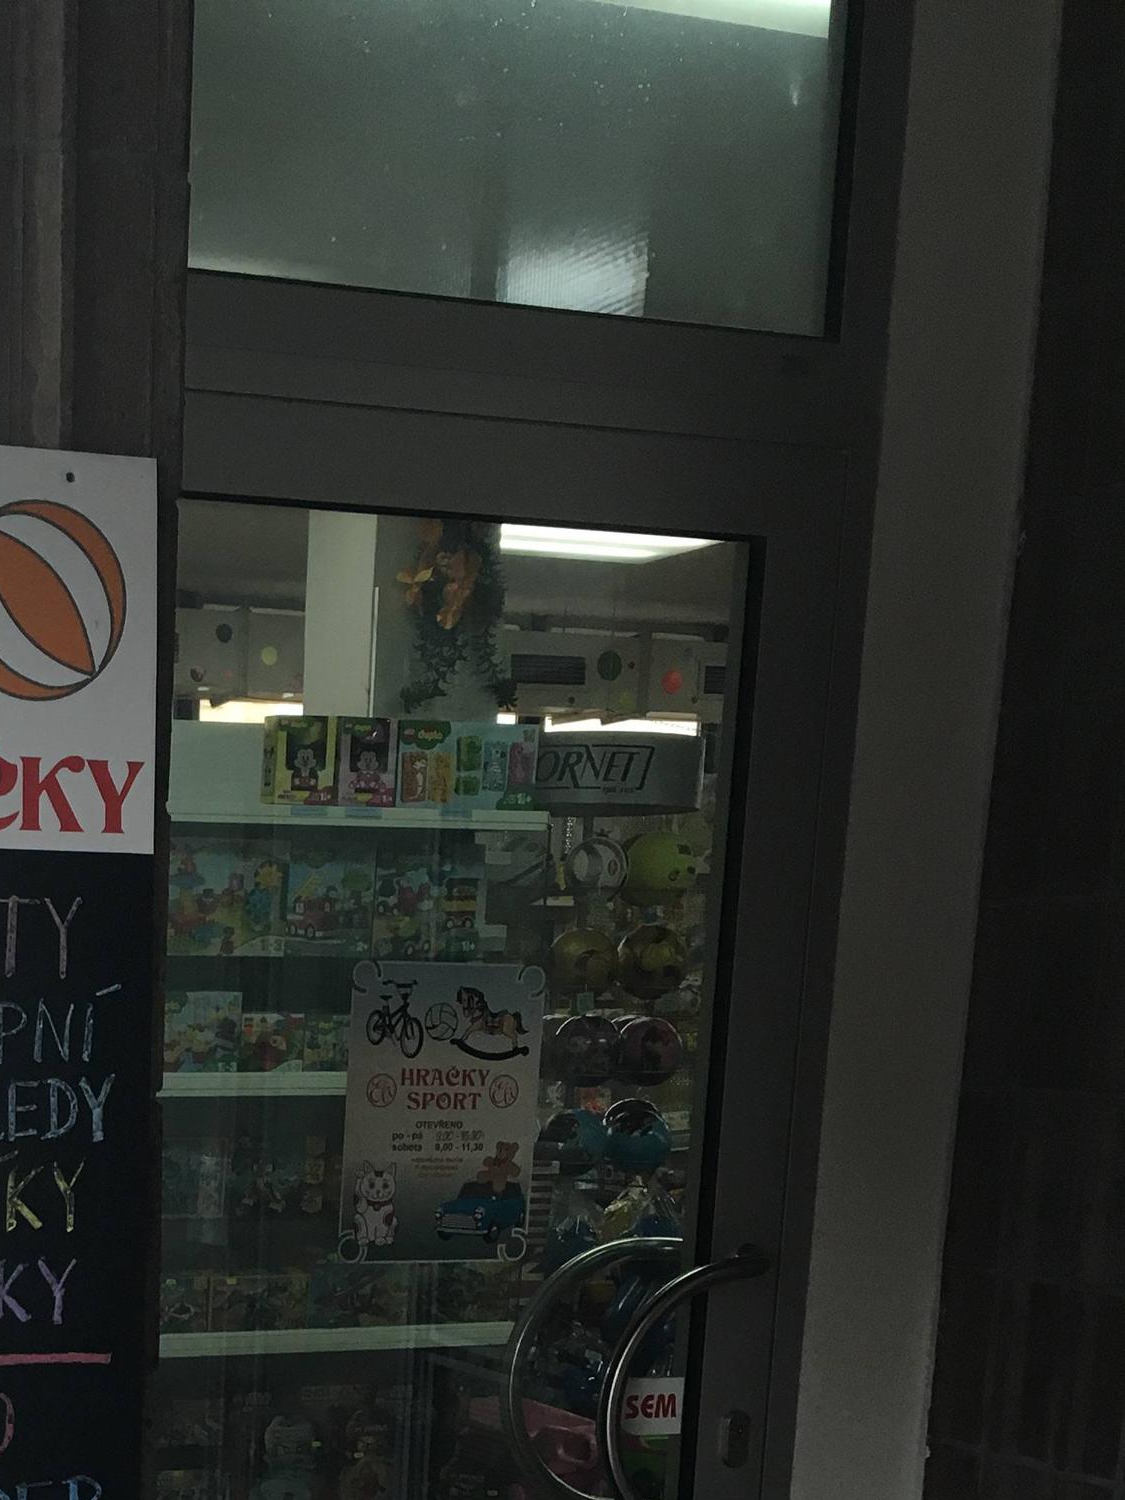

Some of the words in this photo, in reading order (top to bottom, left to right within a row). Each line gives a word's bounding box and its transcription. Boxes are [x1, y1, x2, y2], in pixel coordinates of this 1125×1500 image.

[401, 1065, 490, 1087] HRAČKY
[407, 1091, 482, 1110] SPORT
[415, 1119, 463, 1129] OTEVŘENO
[392, 1143, 423, 1152] sobota
[462, 1143, 484, 1153] 11,30
[625, 1393, 677, 1419] SEM
